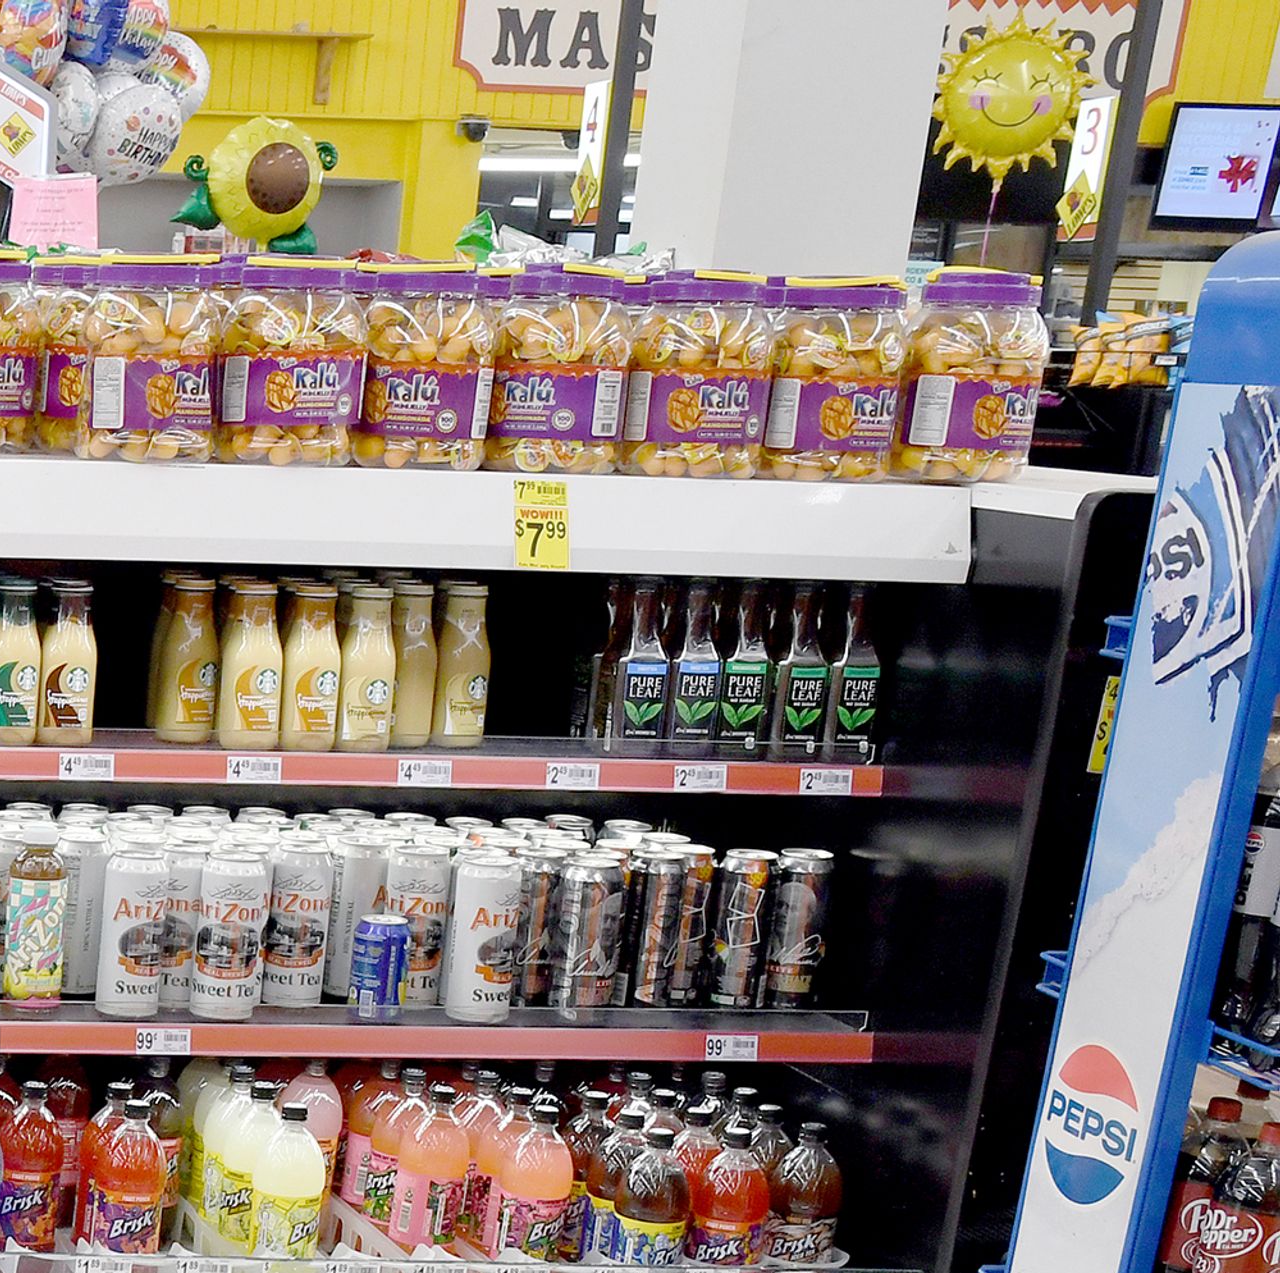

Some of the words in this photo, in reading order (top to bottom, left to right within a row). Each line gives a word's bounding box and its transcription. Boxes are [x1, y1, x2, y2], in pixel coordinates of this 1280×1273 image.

[586, 96, 598, 143] 4
[1081, 107, 1101, 155] 3
[519, 509, 563, 520] WOW!!!
[630, 676, 662, 688] PURE
[682, 675, 714, 687] PURE
[729, 676, 762, 688] PURE
[793, 680, 823, 691] PURE
[846, 680, 877, 691] PURE
[1046, 1089, 1139, 1164] PEPSI
[108, 1210, 153, 1239] Brisk
